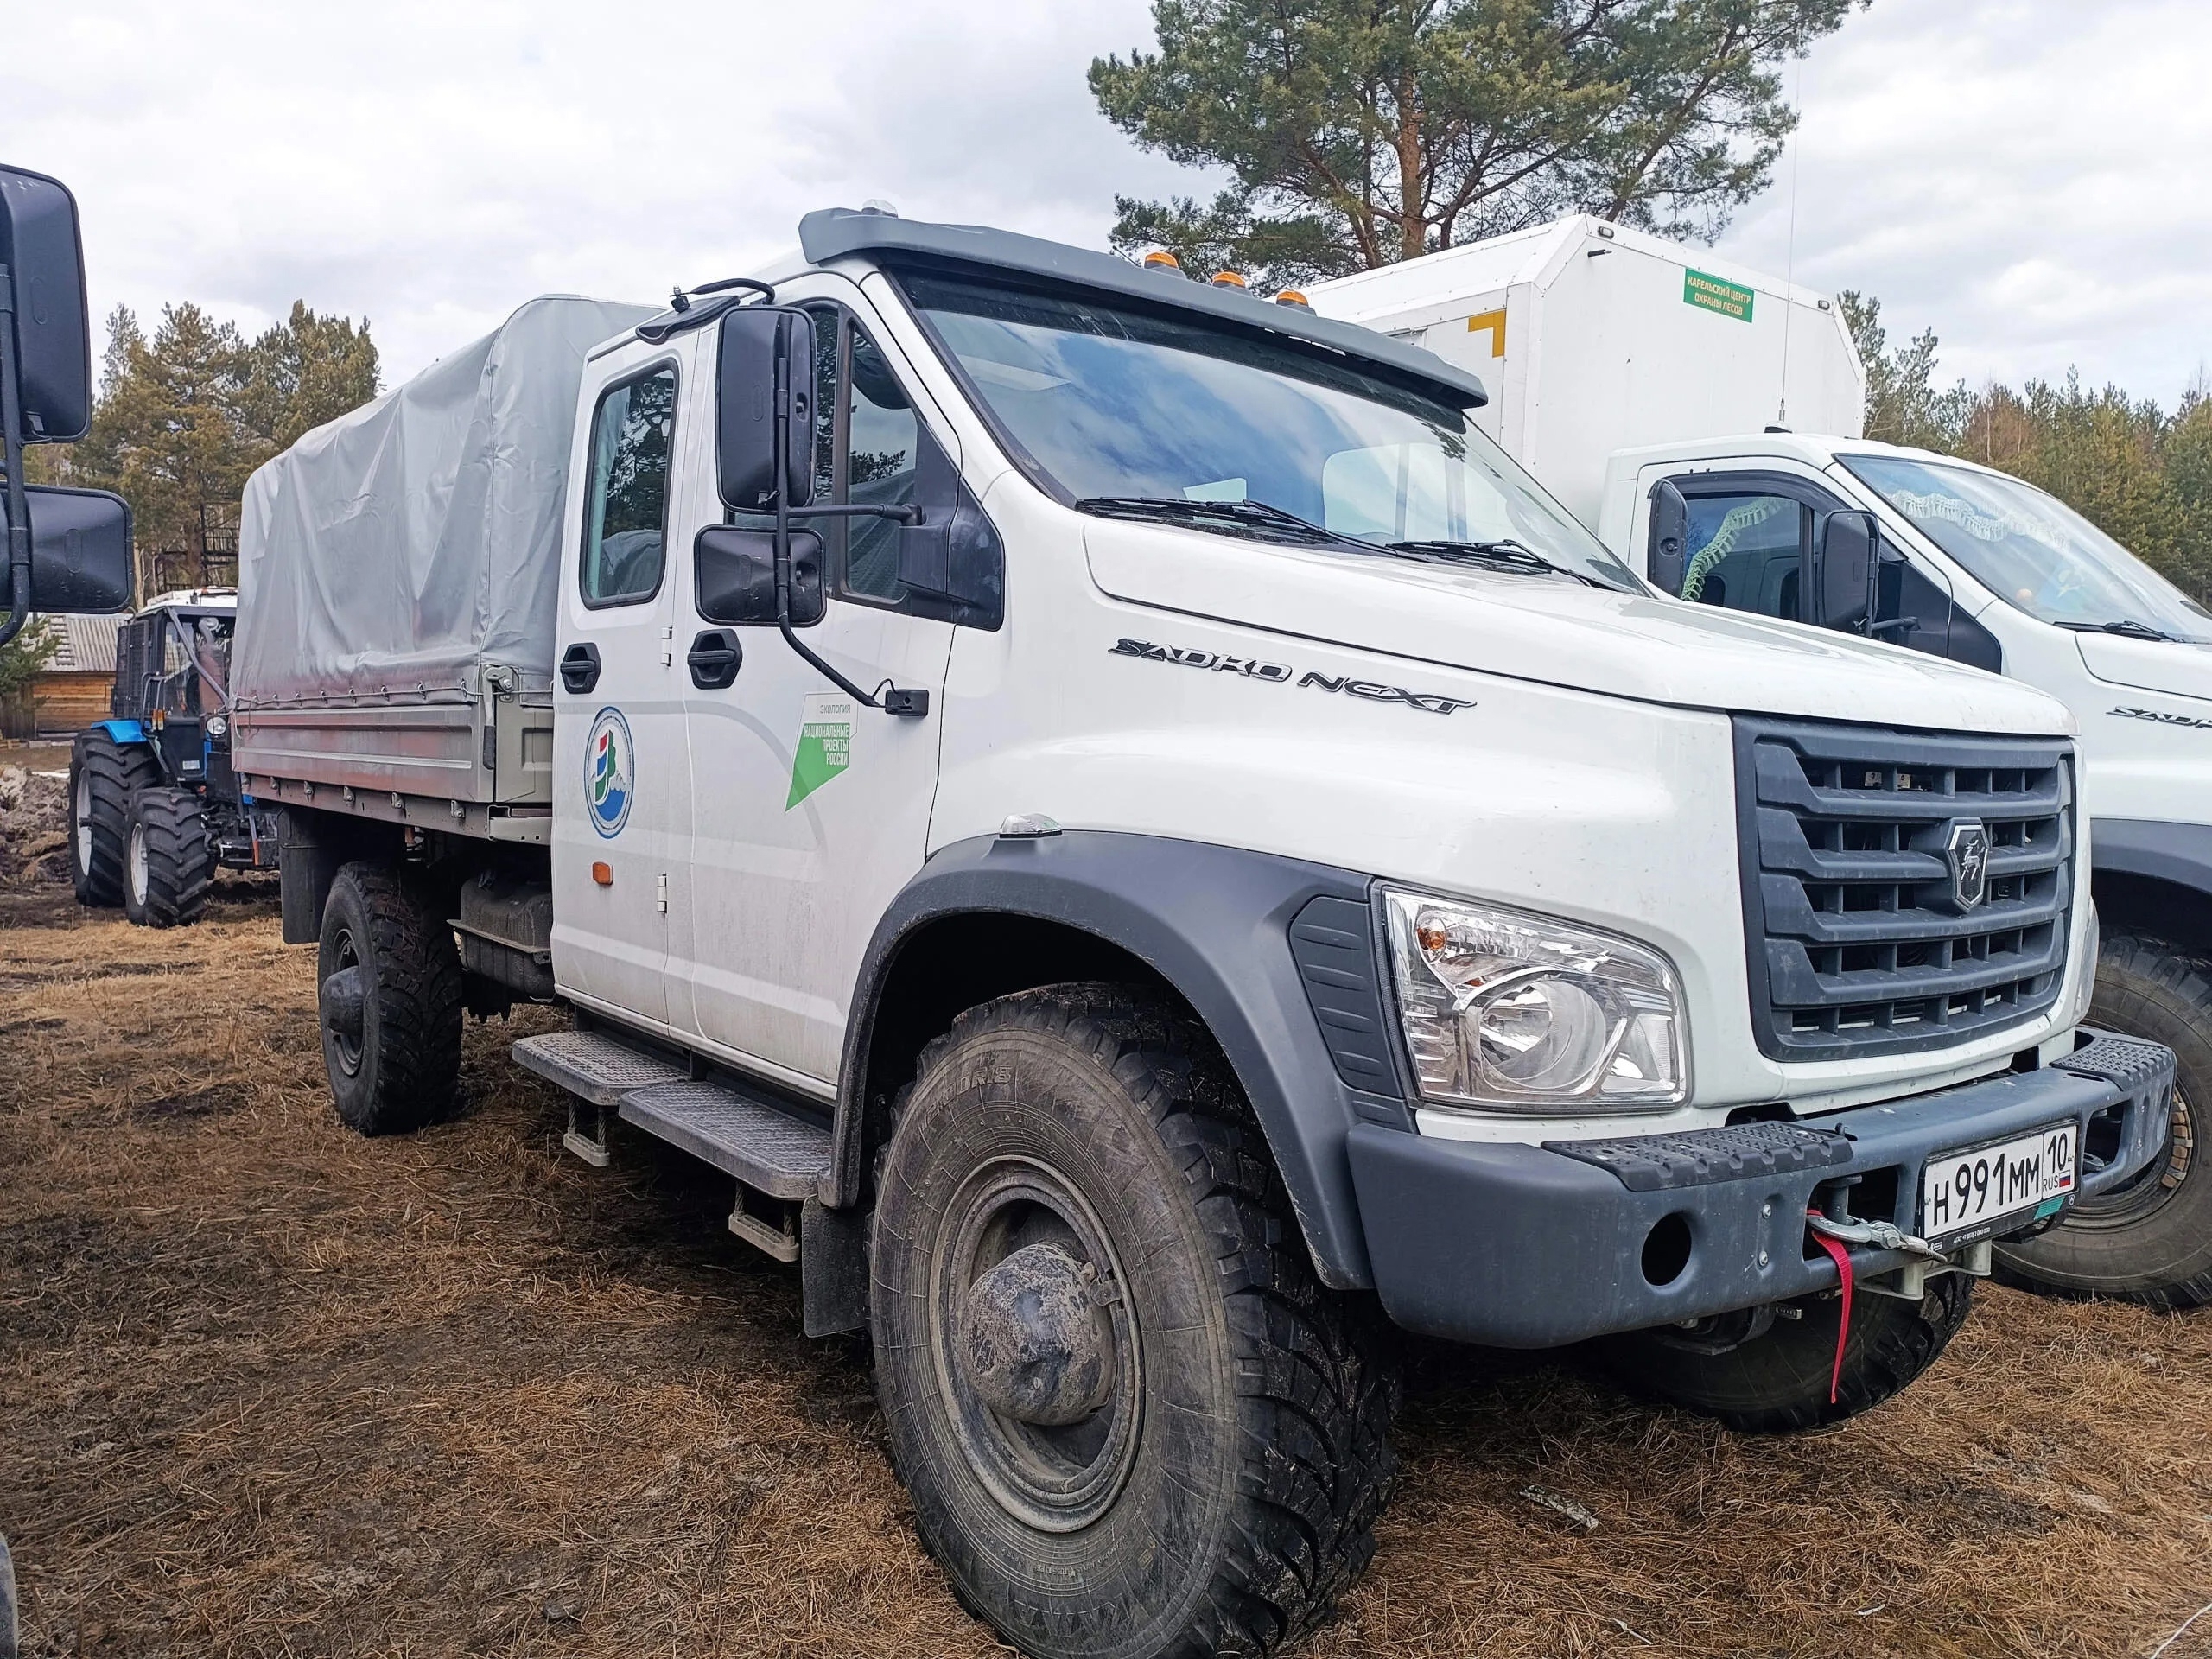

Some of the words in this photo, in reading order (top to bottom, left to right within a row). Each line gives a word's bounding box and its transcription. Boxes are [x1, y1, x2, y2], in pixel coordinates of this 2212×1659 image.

[1688, 276, 1730, 298] КАРЕЛЬСКИЙ
[1730, 289, 1751, 304] ЦЕНТР
[1694, 292, 1722, 309] ОХРАНЫ
[1723, 302, 1743, 315] ЛЕСОВ
[1108, 637, 1293, 683] SADKO
[1296, 671, 1478, 715] NEXT
[820, 704, 851, 715] ЭКОЛОГИЯ
[804, 724, 849, 739] НАЦИОНАЛЬНЫЕ
[822, 738, 849, 752] ПРОЕКТЫ
[826, 753, 849, 766] РОССИИ
[2047, 1132, 2068, 1173] 10
[2043, 1174, 2059, 1192] RUS
